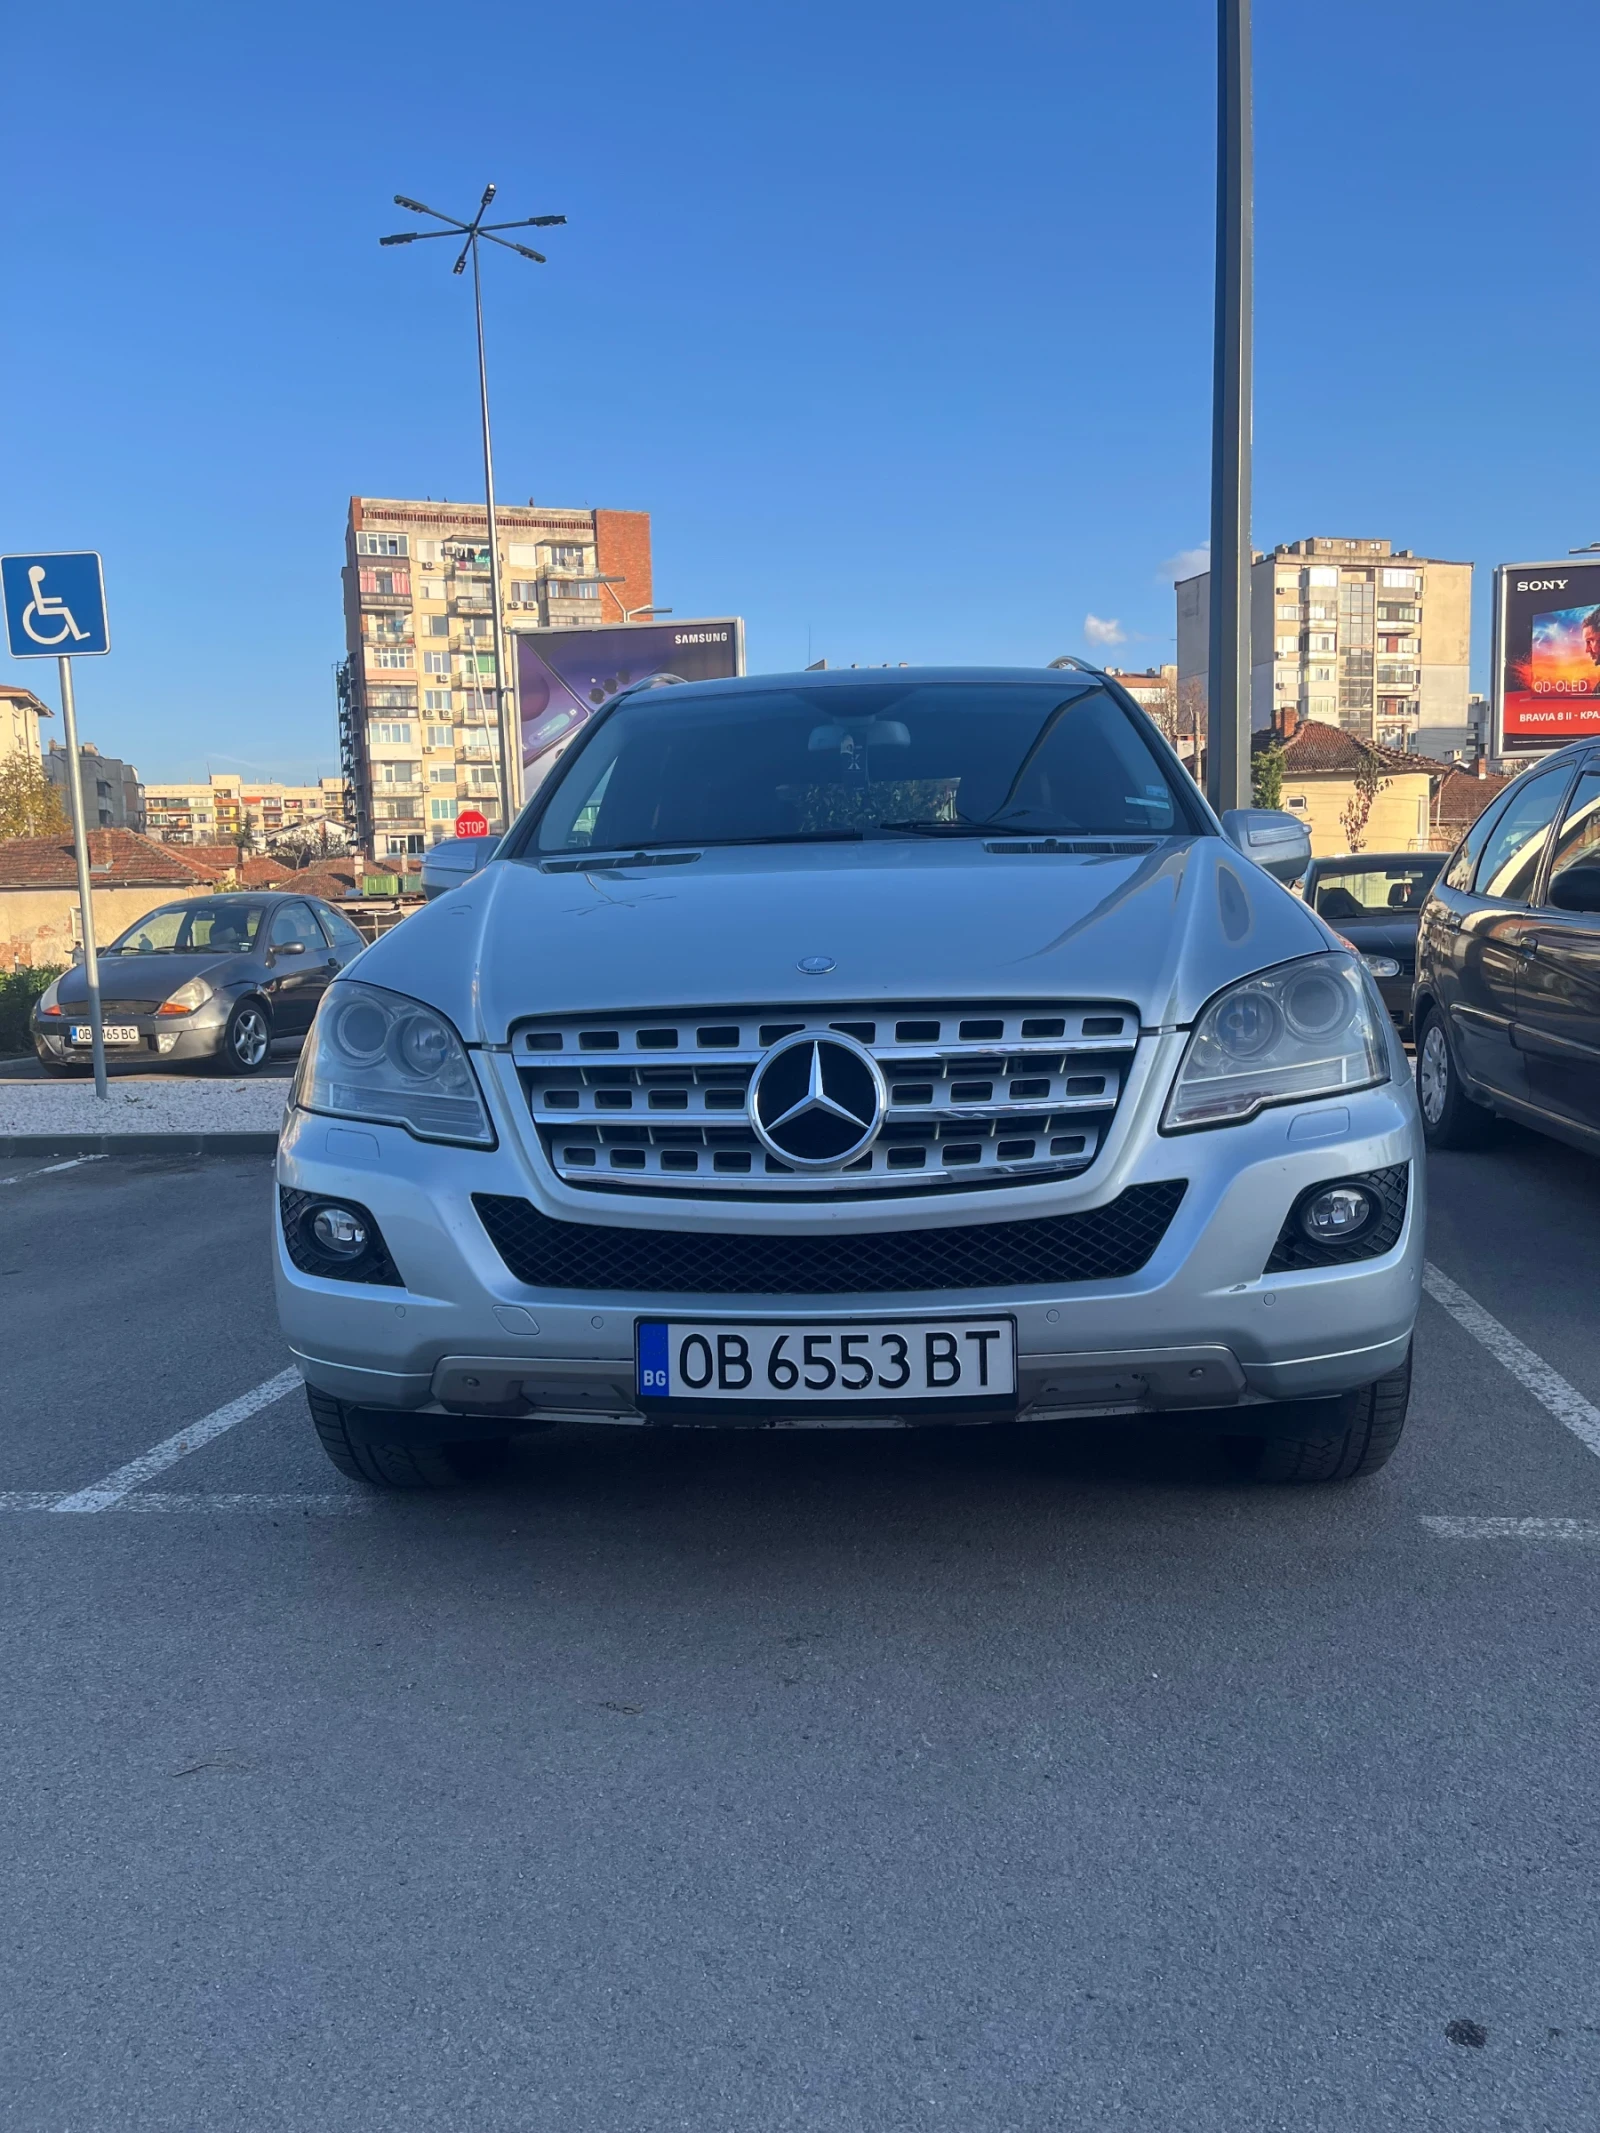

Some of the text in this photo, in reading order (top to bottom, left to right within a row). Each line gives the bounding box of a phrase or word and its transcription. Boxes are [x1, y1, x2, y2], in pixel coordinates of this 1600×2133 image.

[1517, 579, 1568, 592] SONY
[675, 632, 728, 644] SAMSUNG
[1534, 680, 1588, 693] QD-OLED
[1519, 713, 1555, 722] BRAVIA
[1557, 712, 1564, 720] 8
[1566, 712, 1572, 720] II
[1580, 711, 1600, 719] КРА
[458, 821, 485, 834] STOP
[102, 1028, 119, 1040] 65
[121, 1028, 136, 1040] BC
[679, 1329, 1001, 1391] OB 6553 BT
[643, 1369, 667, 1387] BG
